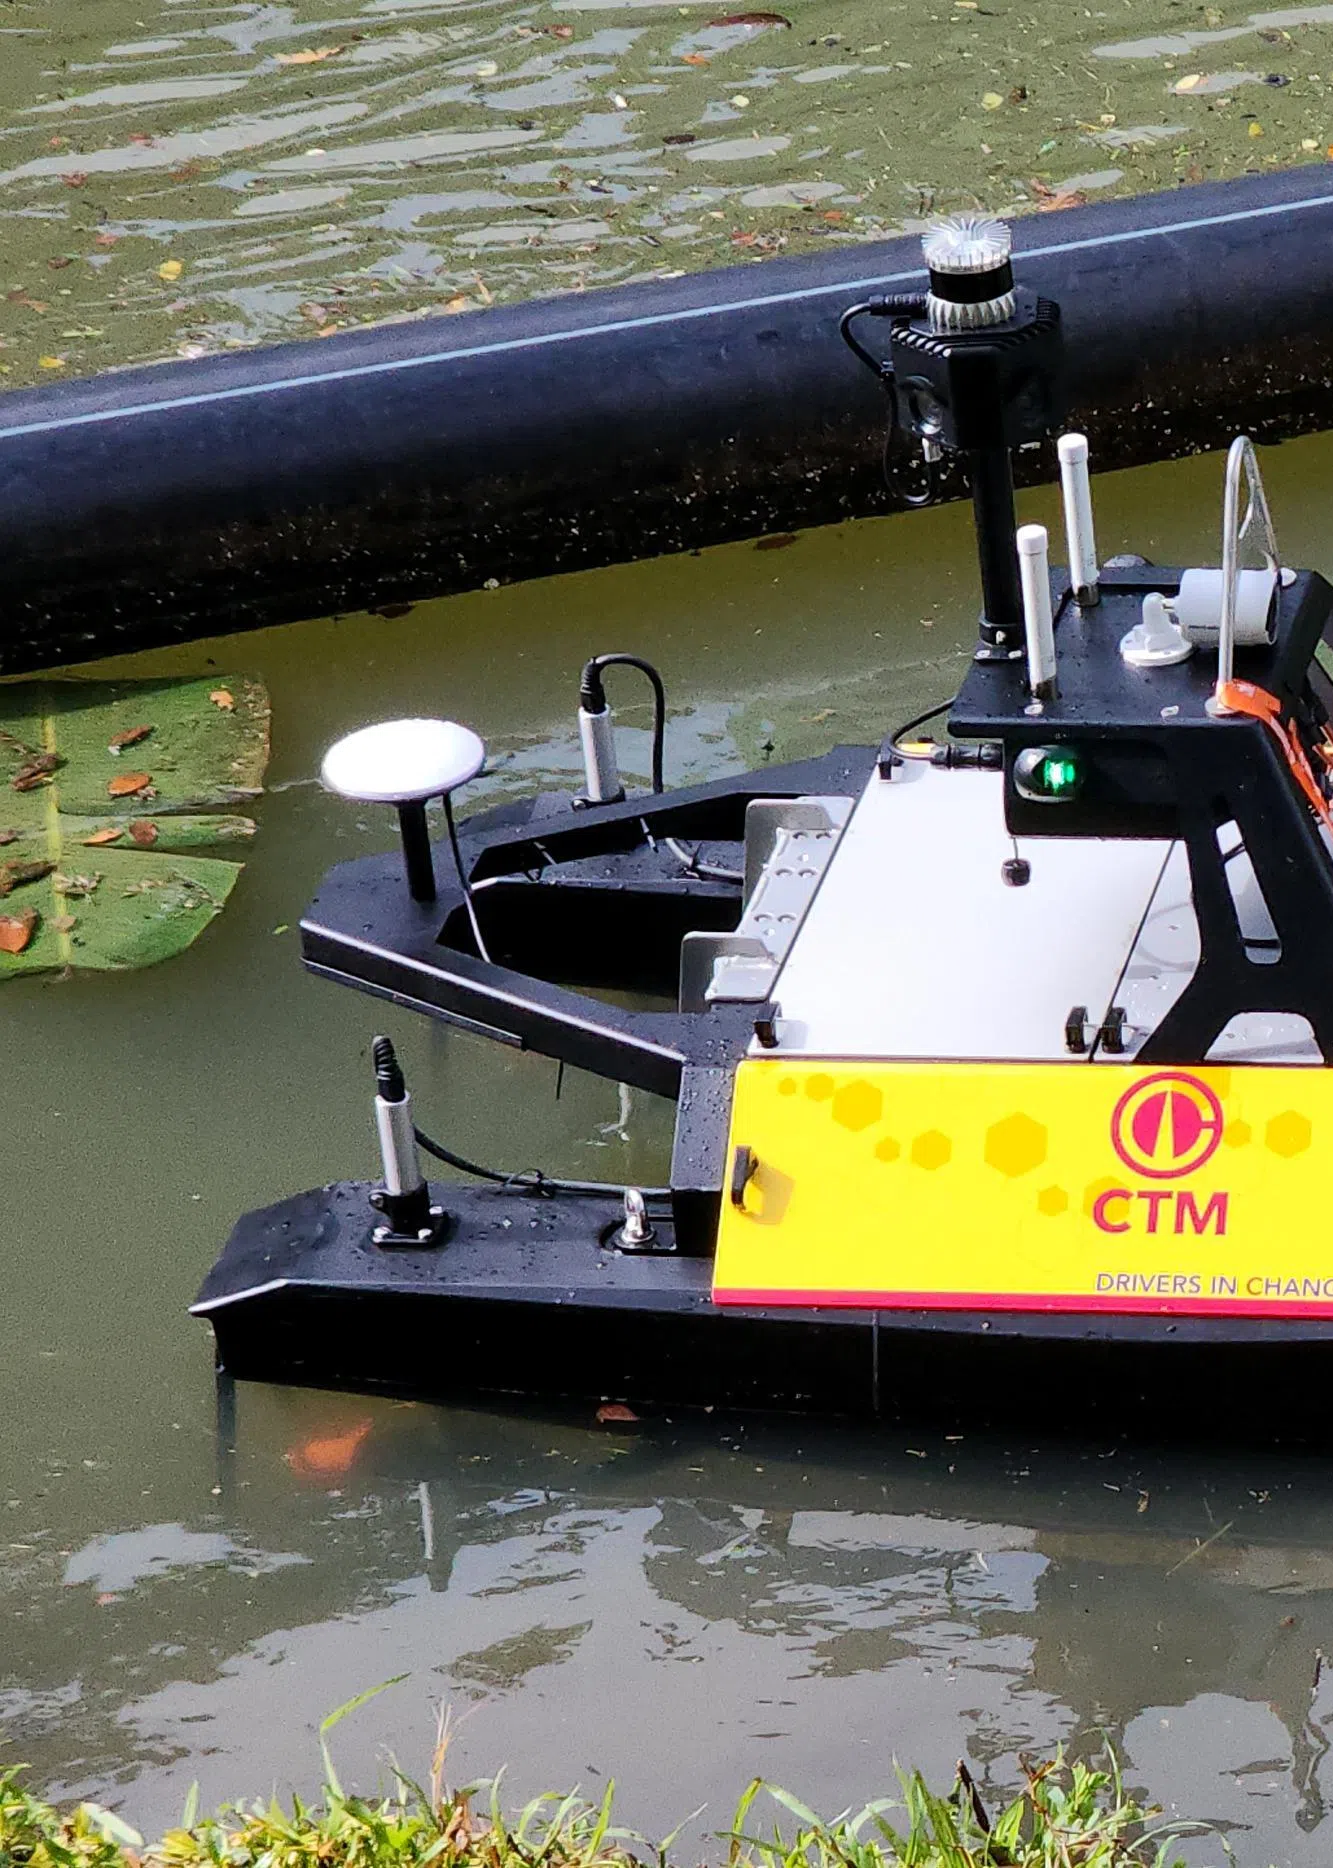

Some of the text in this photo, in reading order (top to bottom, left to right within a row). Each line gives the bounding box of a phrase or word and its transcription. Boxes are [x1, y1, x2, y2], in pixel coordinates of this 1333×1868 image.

[1093, 1188, 1229, 1235] CTM
[1096, 1273, 1201, 1294] DRIVERS
[1211, 1276, 1237, 1295] IN
